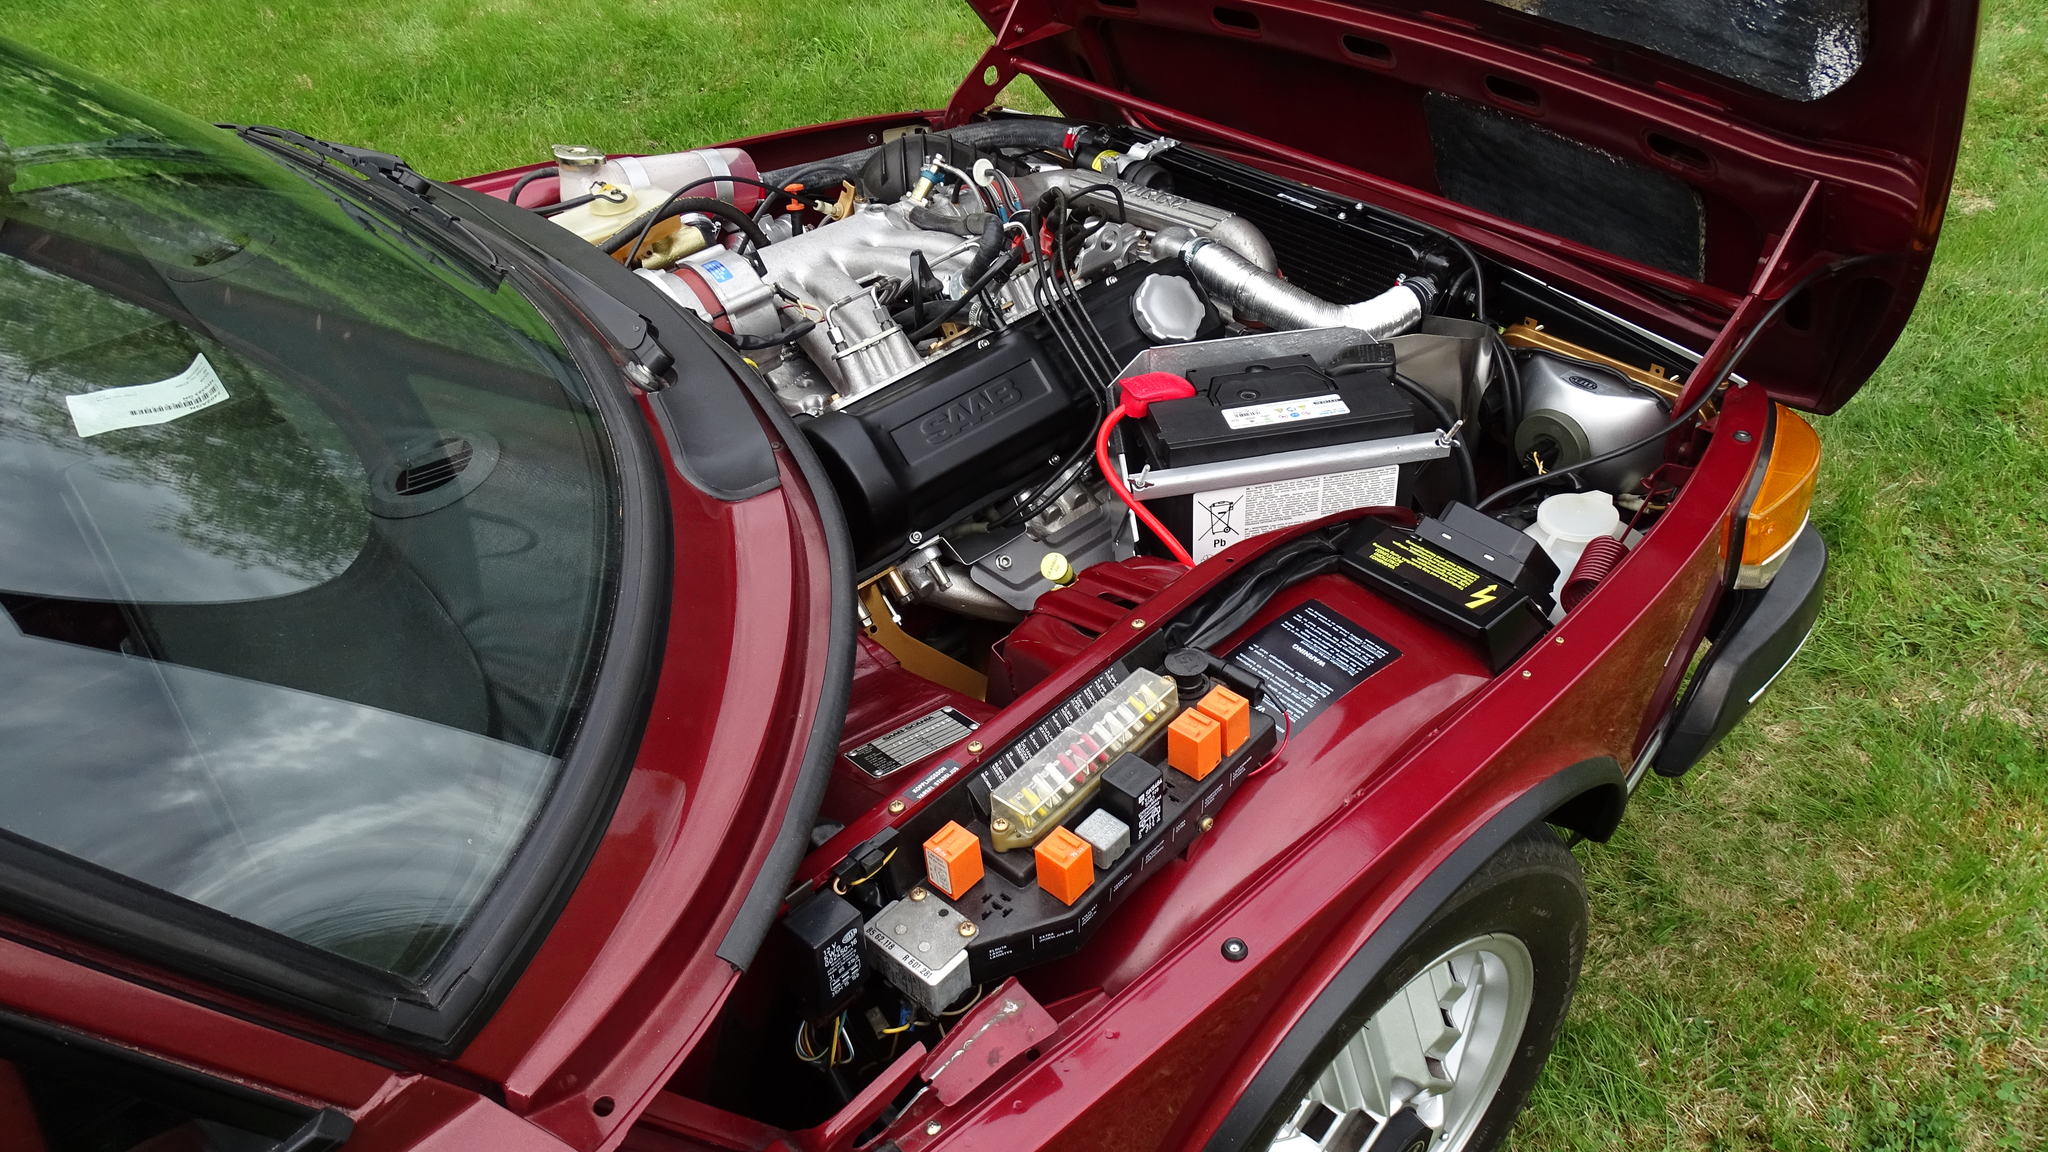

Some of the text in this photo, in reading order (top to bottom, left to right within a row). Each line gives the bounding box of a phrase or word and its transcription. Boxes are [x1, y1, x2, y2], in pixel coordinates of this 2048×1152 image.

[920, 379, 1022, 445] SAAB
[1213, 539, 1226, 548] Pb
[1292, 643, 1326, 667] WARNING
